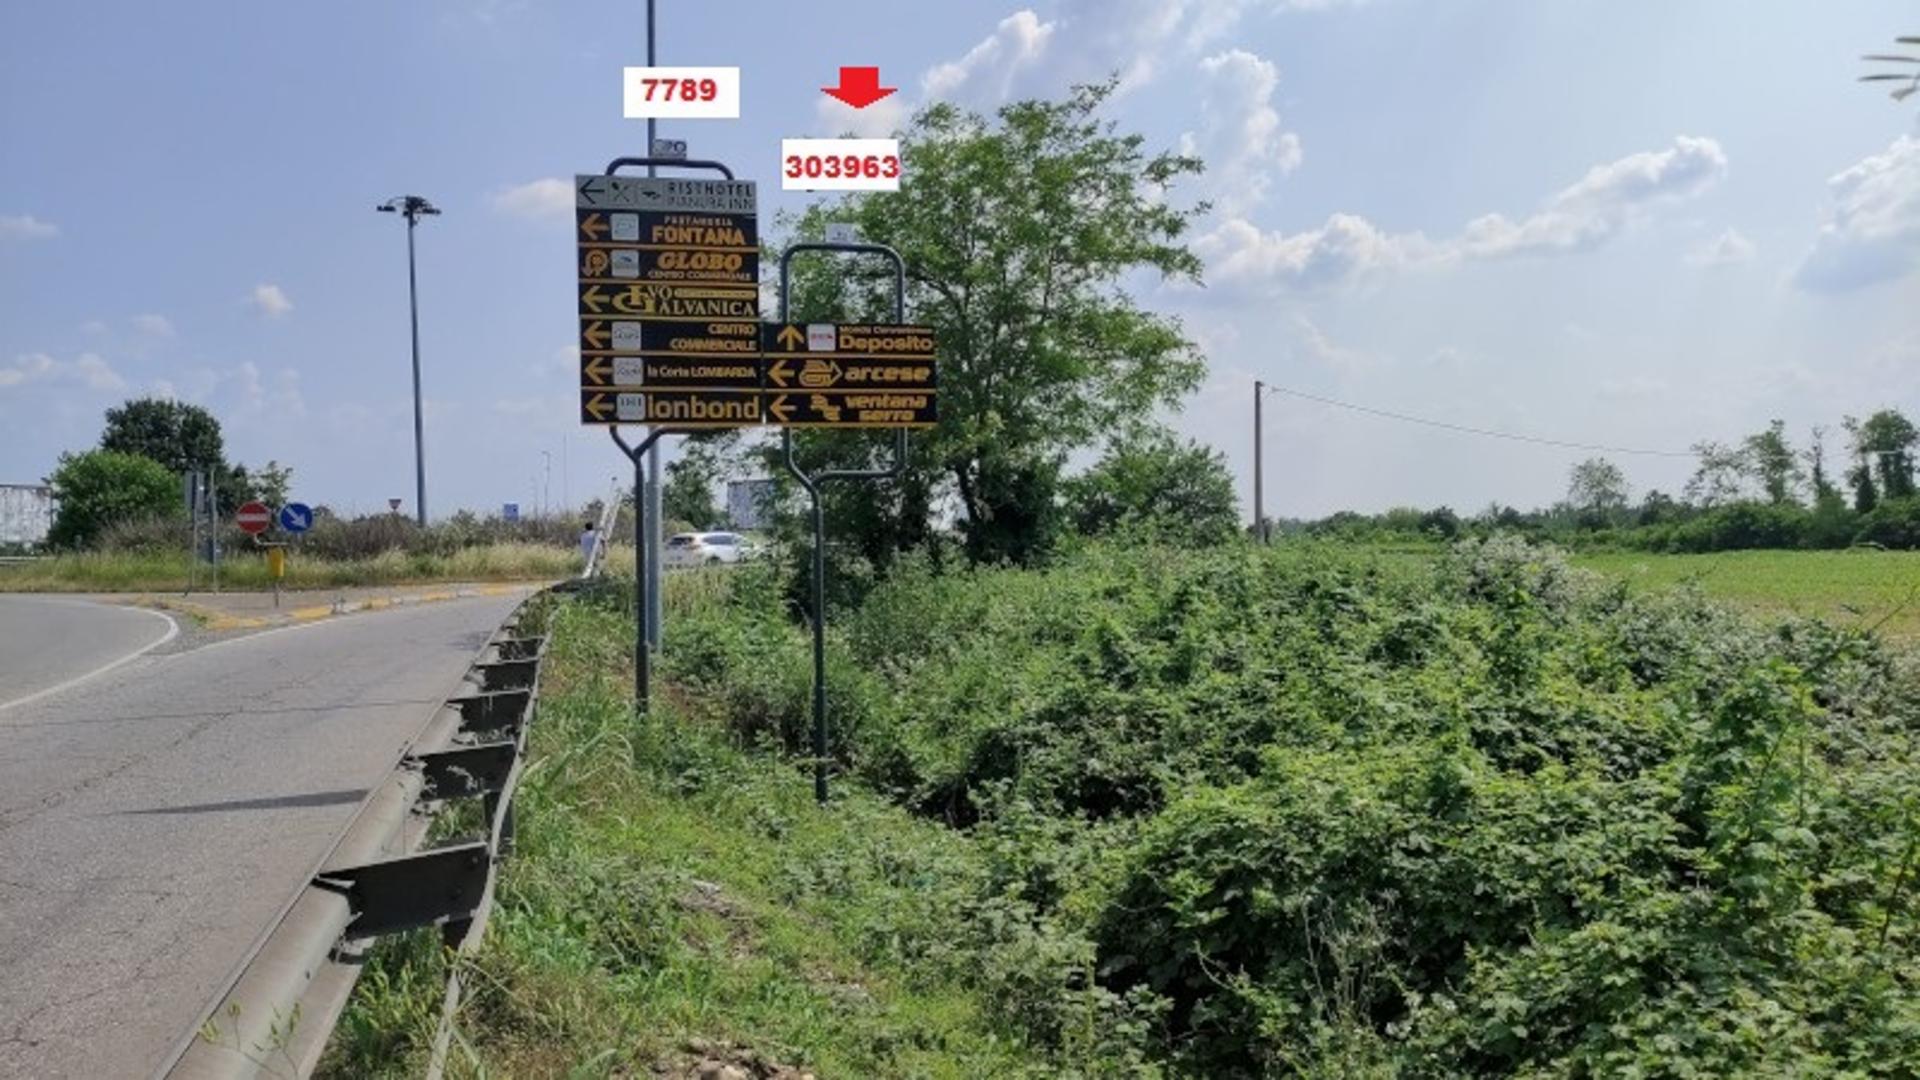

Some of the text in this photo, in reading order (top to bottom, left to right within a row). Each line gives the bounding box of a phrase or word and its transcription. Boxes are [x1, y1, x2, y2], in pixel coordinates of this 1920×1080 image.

[652, 225, 746, 246] FONTANA
[657, 251, 743, 272] GLOBO
[648, 270, 685, 280] CENTRO
[707, 323, 757, 336] CENTRO
[669, 338, 757, 351] COMMERCIALE
[839, 335, 933, 353] Deposito
[691, 366, 757, 378] LOMBARDA
[845, 366, 931, 381] arcese
[845, 394, 928, 409] ventana
